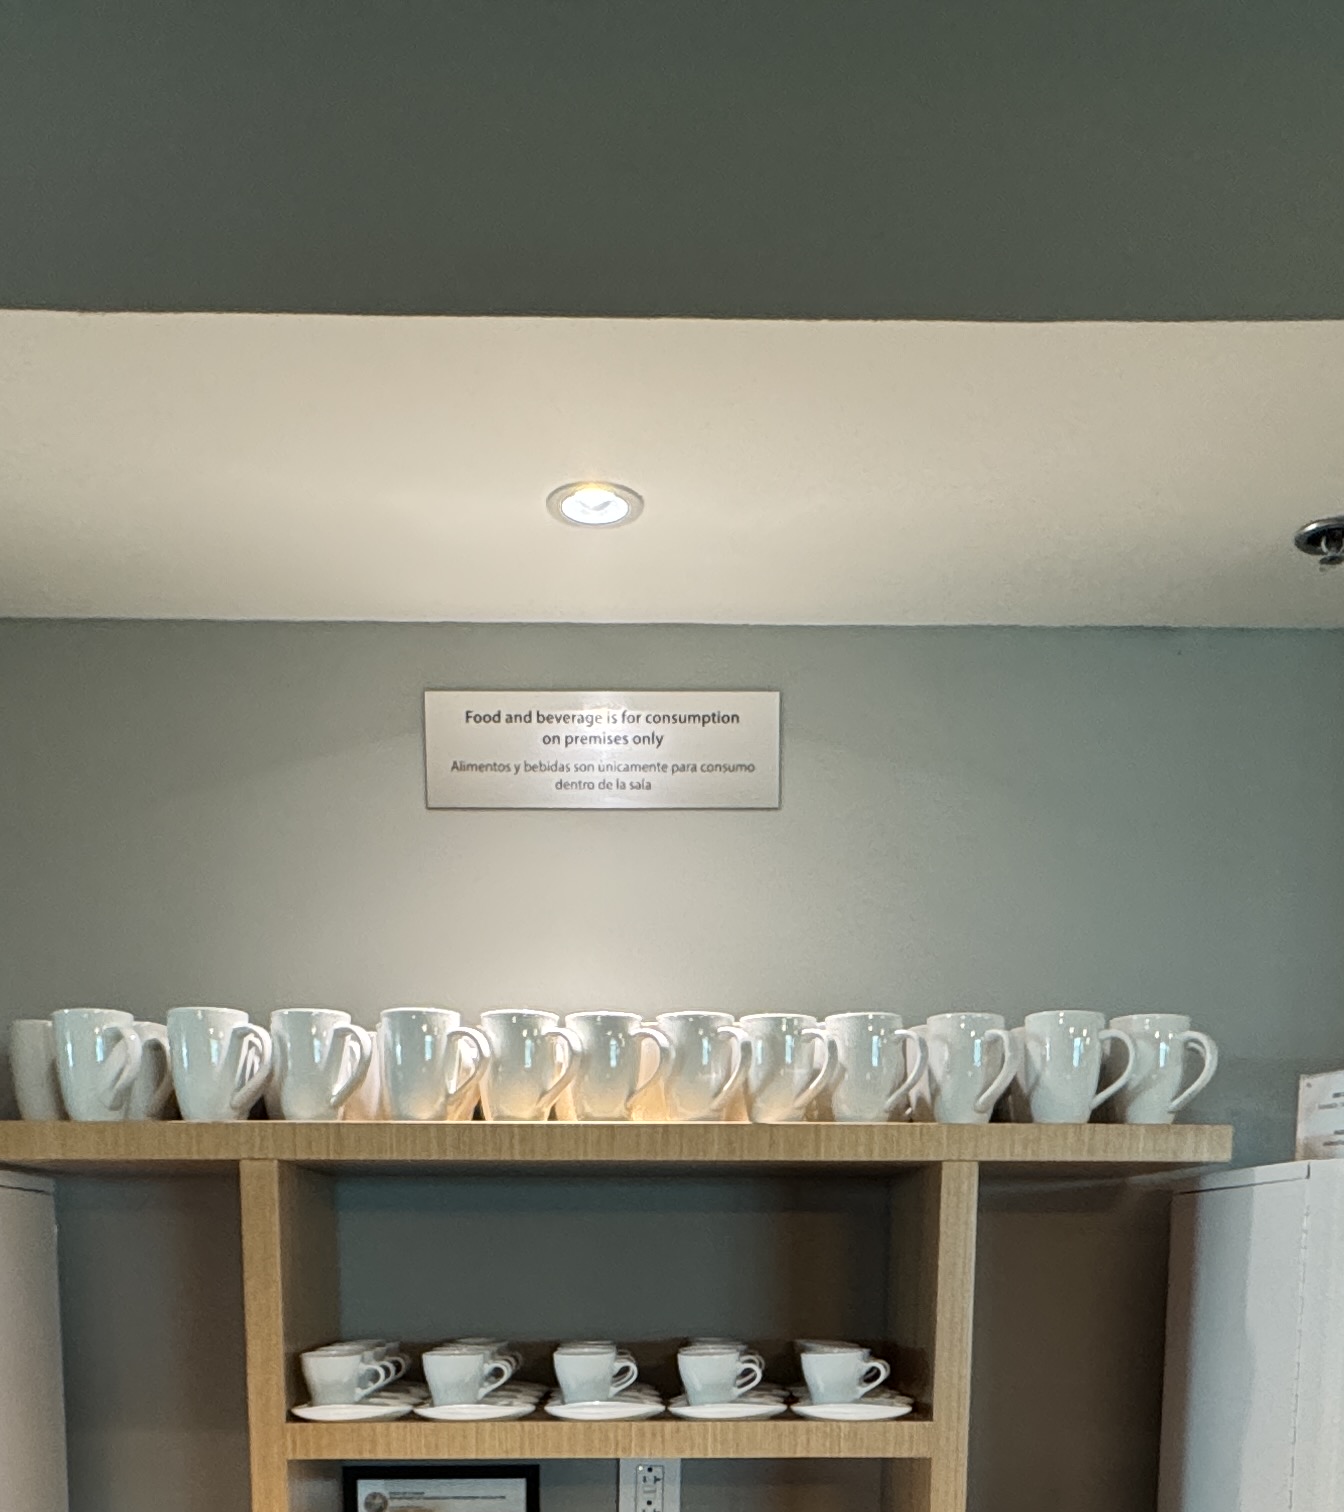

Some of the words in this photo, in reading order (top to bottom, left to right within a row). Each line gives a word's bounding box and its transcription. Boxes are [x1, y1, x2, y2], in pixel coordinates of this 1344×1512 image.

[465, 710, 502, 724] Food
[505, 710, 533, 724] and
[536, 710, 603, 727] beverage
[607, 711, 618, 724] is
[621, 710, 642, 724] for
[645, 711, 740, 727] consumption
[542, 734, 561, 745] on
[564, 732, 629, 748] premises
[633, 730, 664, 749] only
[450, 760, 512, 773] Alimentos
[513, 762, 521, 775] y
[524, 760, 571, 773] bebidas
[574, 762, 595, 773] son
[671, 762, 698, 775] para
[700, 762, 756, 773] consumo
[554, 779, 595, 790] dentro
[598, 779, 613, 790] de
[616, 778, 627, 790] la
[629, 778, 652, 790] sala
